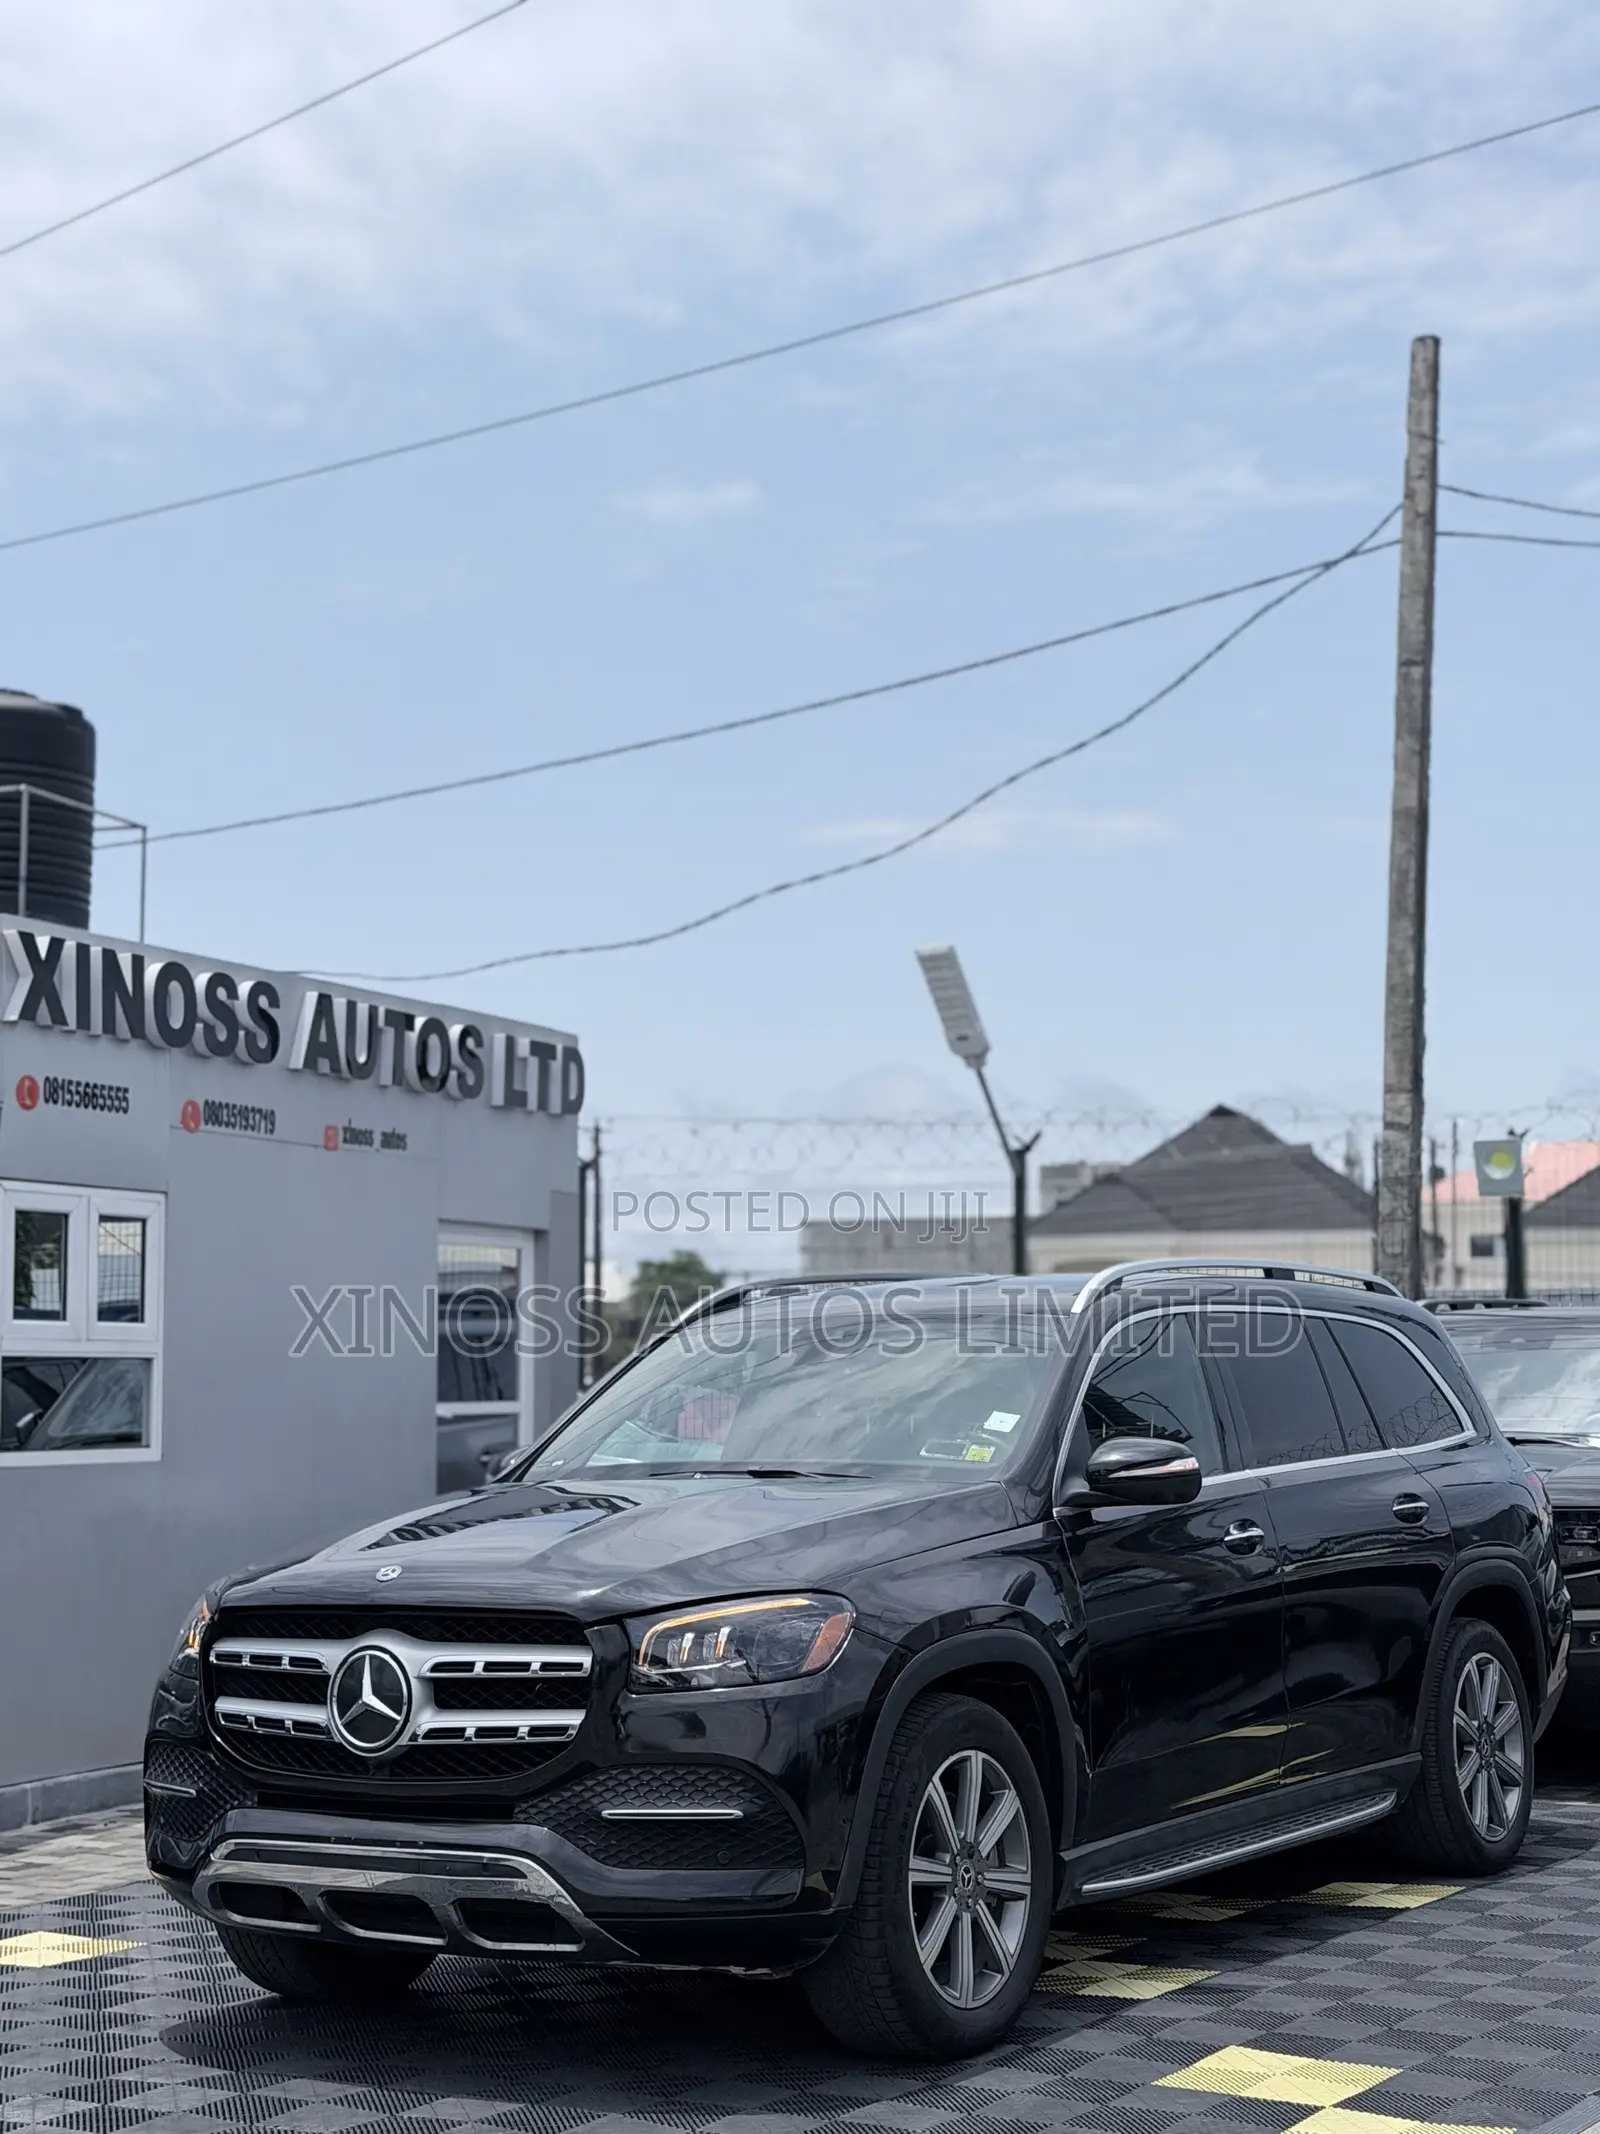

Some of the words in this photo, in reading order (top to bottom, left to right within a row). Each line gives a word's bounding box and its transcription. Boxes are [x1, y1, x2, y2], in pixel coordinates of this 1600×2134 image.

[4, 928, 281, 1065] XINOSS
[289, 990, 485, 1100] AUTOS
[491, 1033, 586, 1116] LTD
[43, 1075, 130, 1115] 08155665555
[202, 1099, 277, 1136] 08035193719
